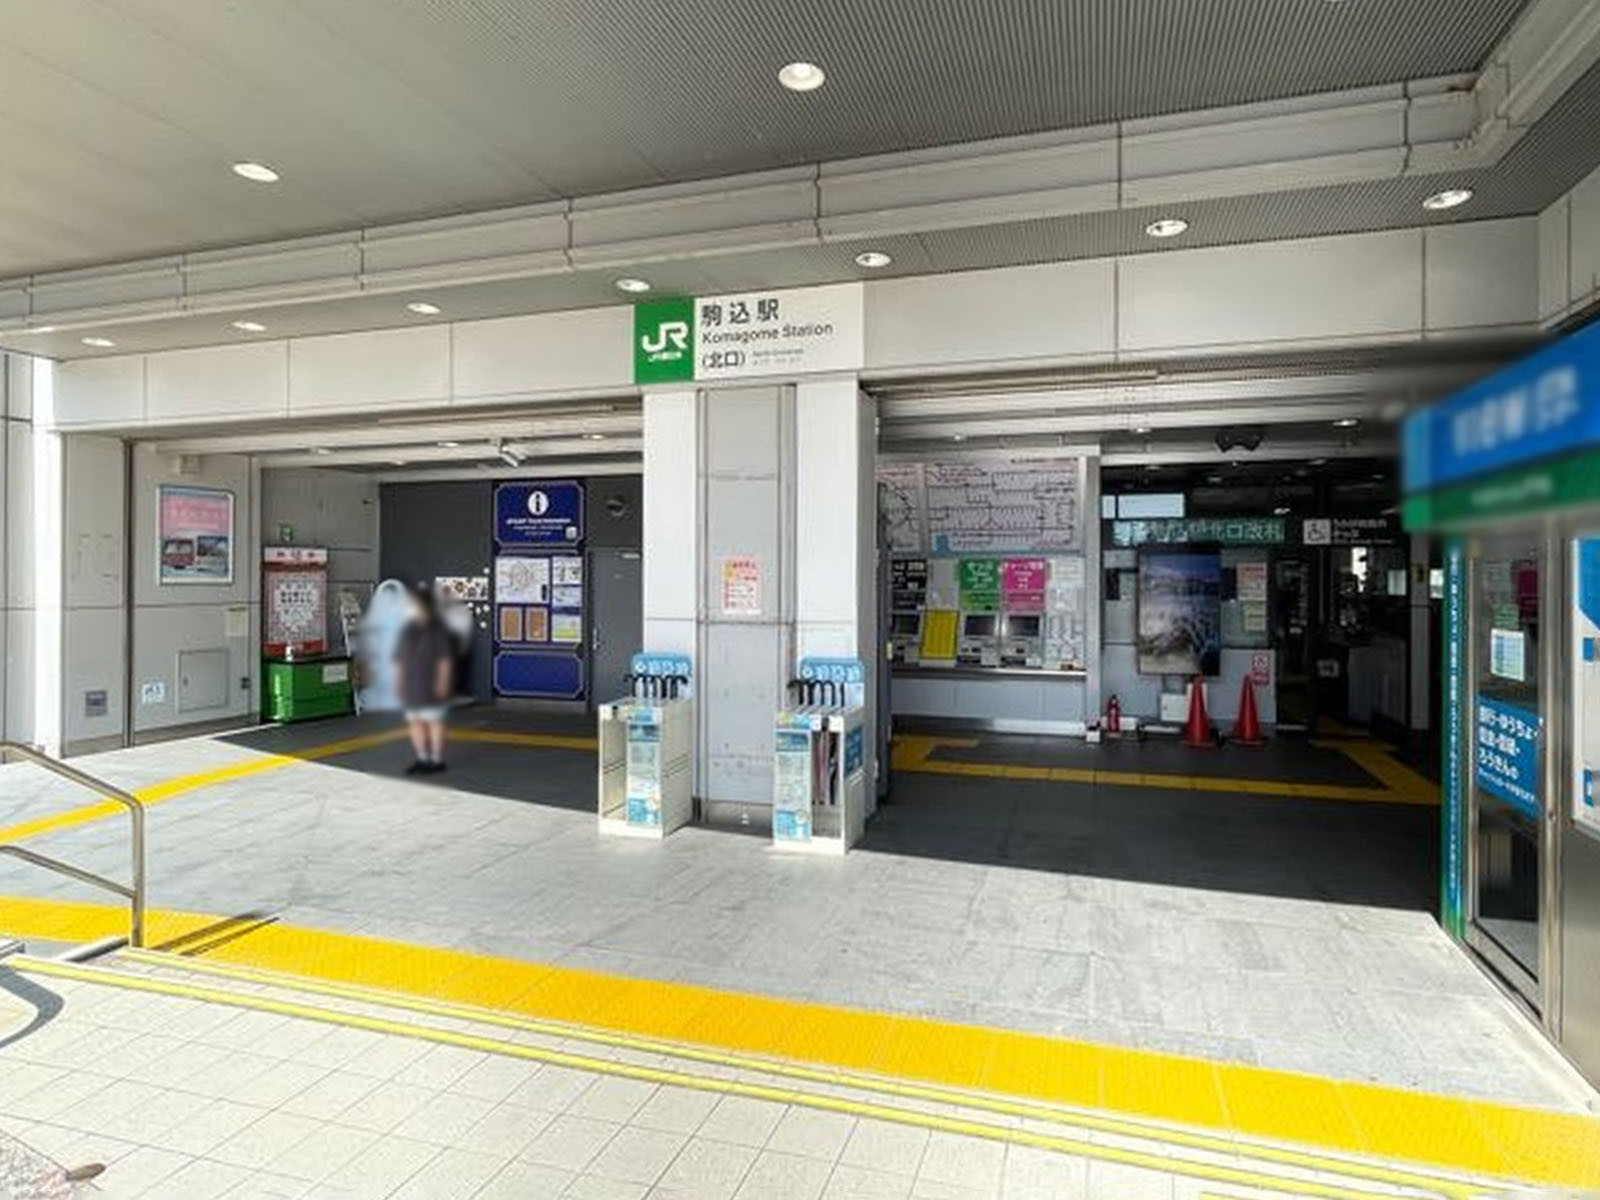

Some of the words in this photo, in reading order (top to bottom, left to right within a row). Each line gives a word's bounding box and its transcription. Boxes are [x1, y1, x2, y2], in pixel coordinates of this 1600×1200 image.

[702, 299, 779, 326] 駒込駅
[642, 322, 688, 351] JR
[702, 329, 779, 345] Komagome
[782, 324, 833, 336] Station
